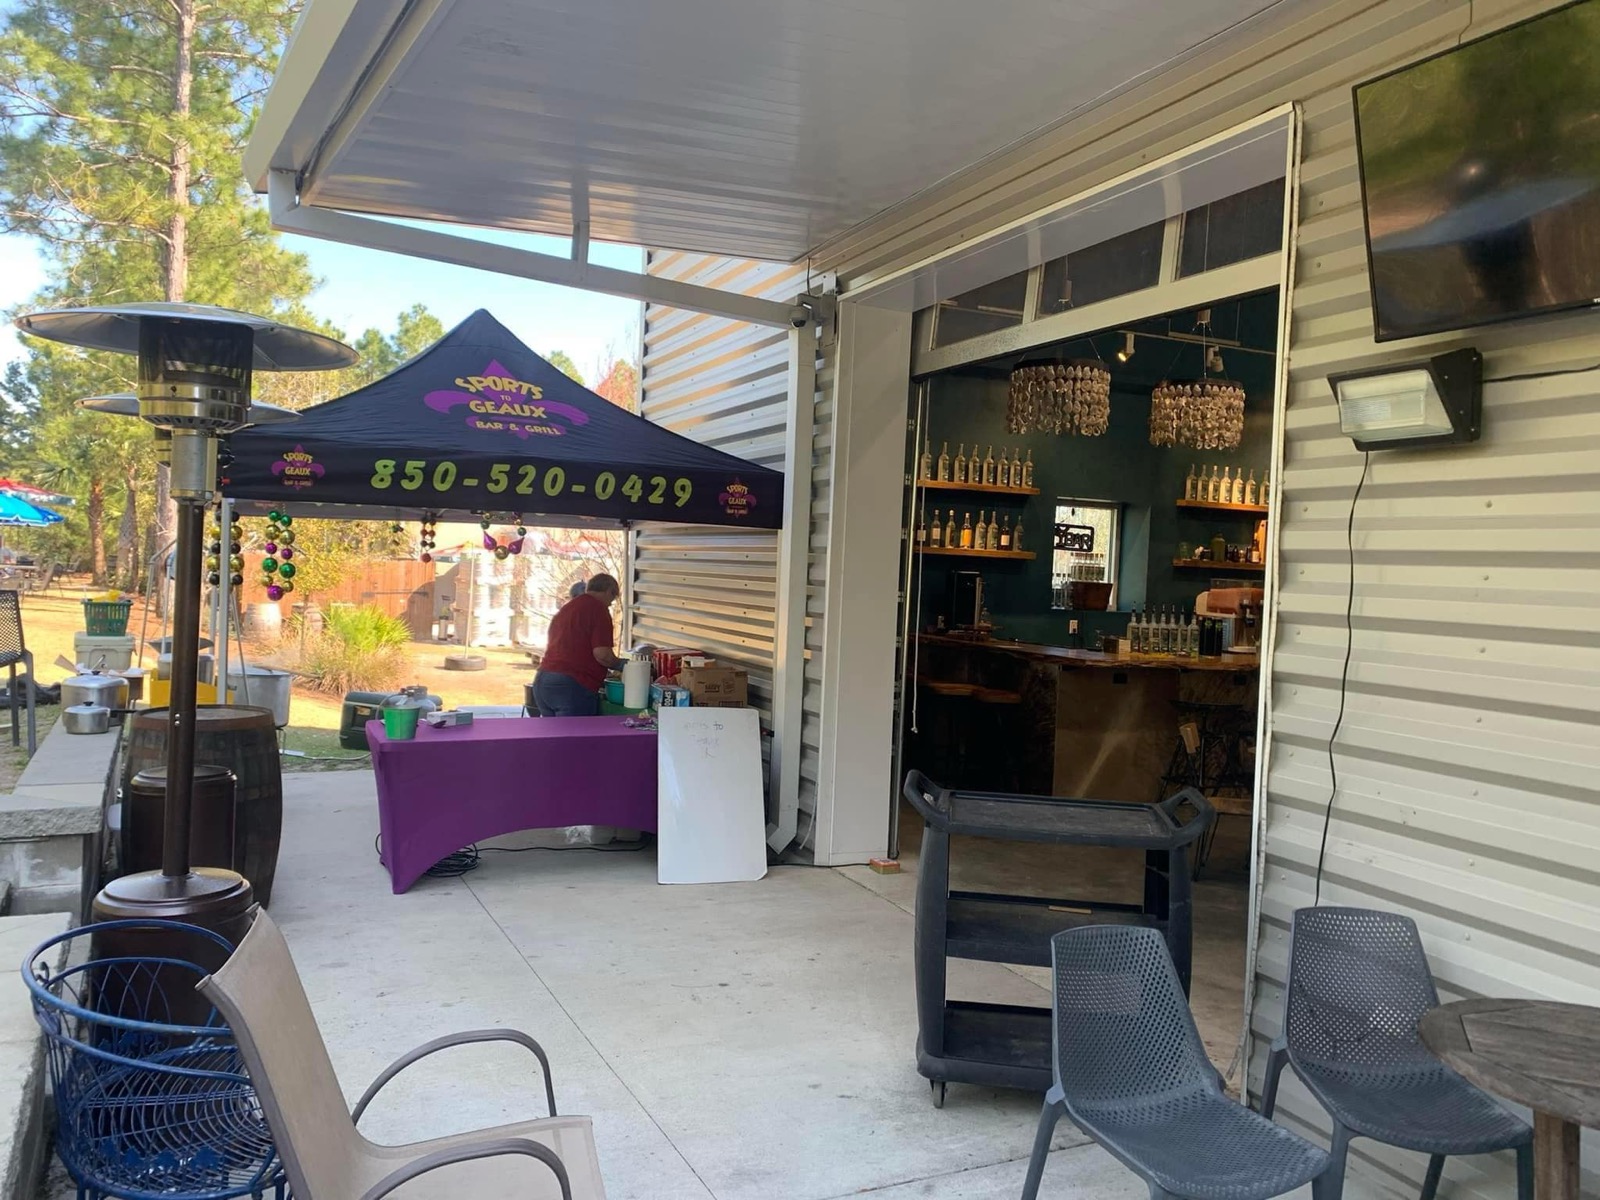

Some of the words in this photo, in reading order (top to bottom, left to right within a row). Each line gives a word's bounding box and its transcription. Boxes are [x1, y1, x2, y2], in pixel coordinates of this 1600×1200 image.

[454, 375, 543, 400] SPORTS
[469, 400, 547, 419] GEAUX
[475, 421, 503, 430] BAR
[509, 423, 519, 431] &
[525, 425, 561, 435] GRILL
[283, 452, 313, 463] SPORTS
[285, 467, 311, 475] GEAUX
[370, 459, 693, 507] 850-520-0429
